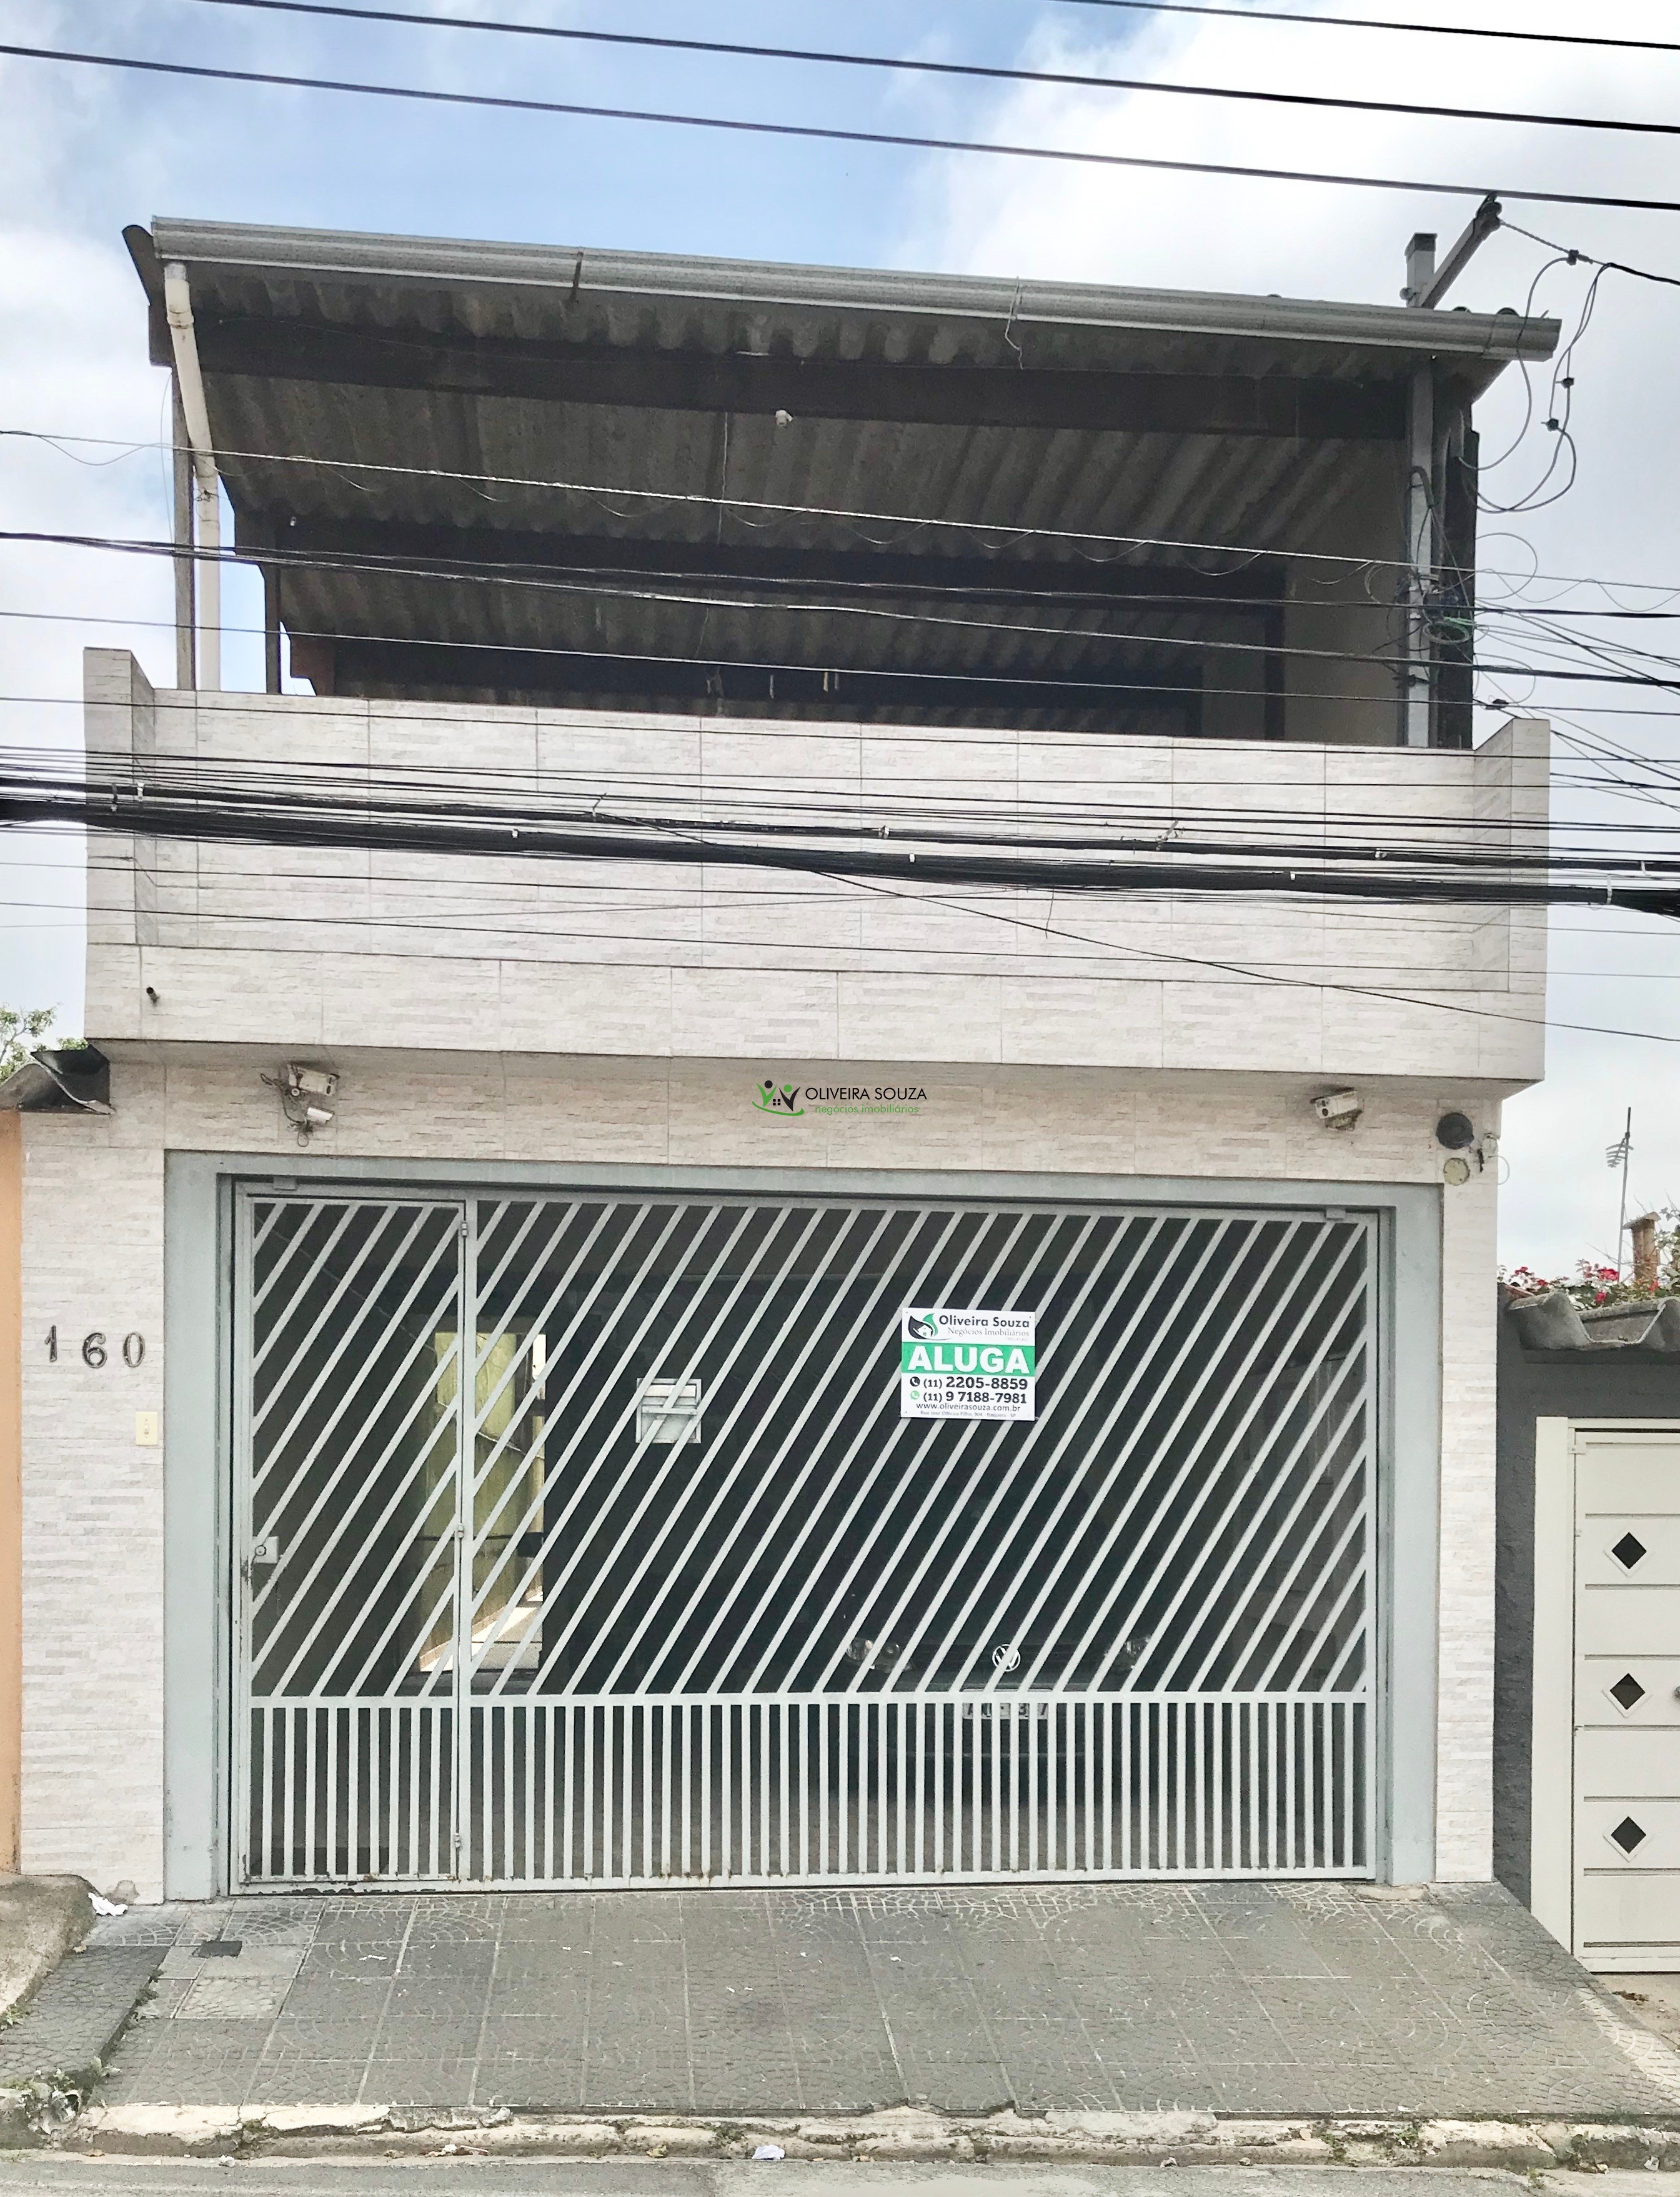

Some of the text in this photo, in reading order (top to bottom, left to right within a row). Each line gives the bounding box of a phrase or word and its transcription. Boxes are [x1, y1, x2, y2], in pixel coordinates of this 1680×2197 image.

[939, 1315, 1030, 1328] Oliveira Souza
[948, 1327, 1030, 1337] Negócios Imobiliários
[44, 1325, 146, 1369] 160
[907, 1345, 1030, 1374] ALUGA
[923, 1376, 1028, 1390] (11) 2205-8859
[923, 1391, 1027, 1404] (11) 9 7188-7981
[916, 1403, 1021, 1412] www.oliveirasouza.com.br
